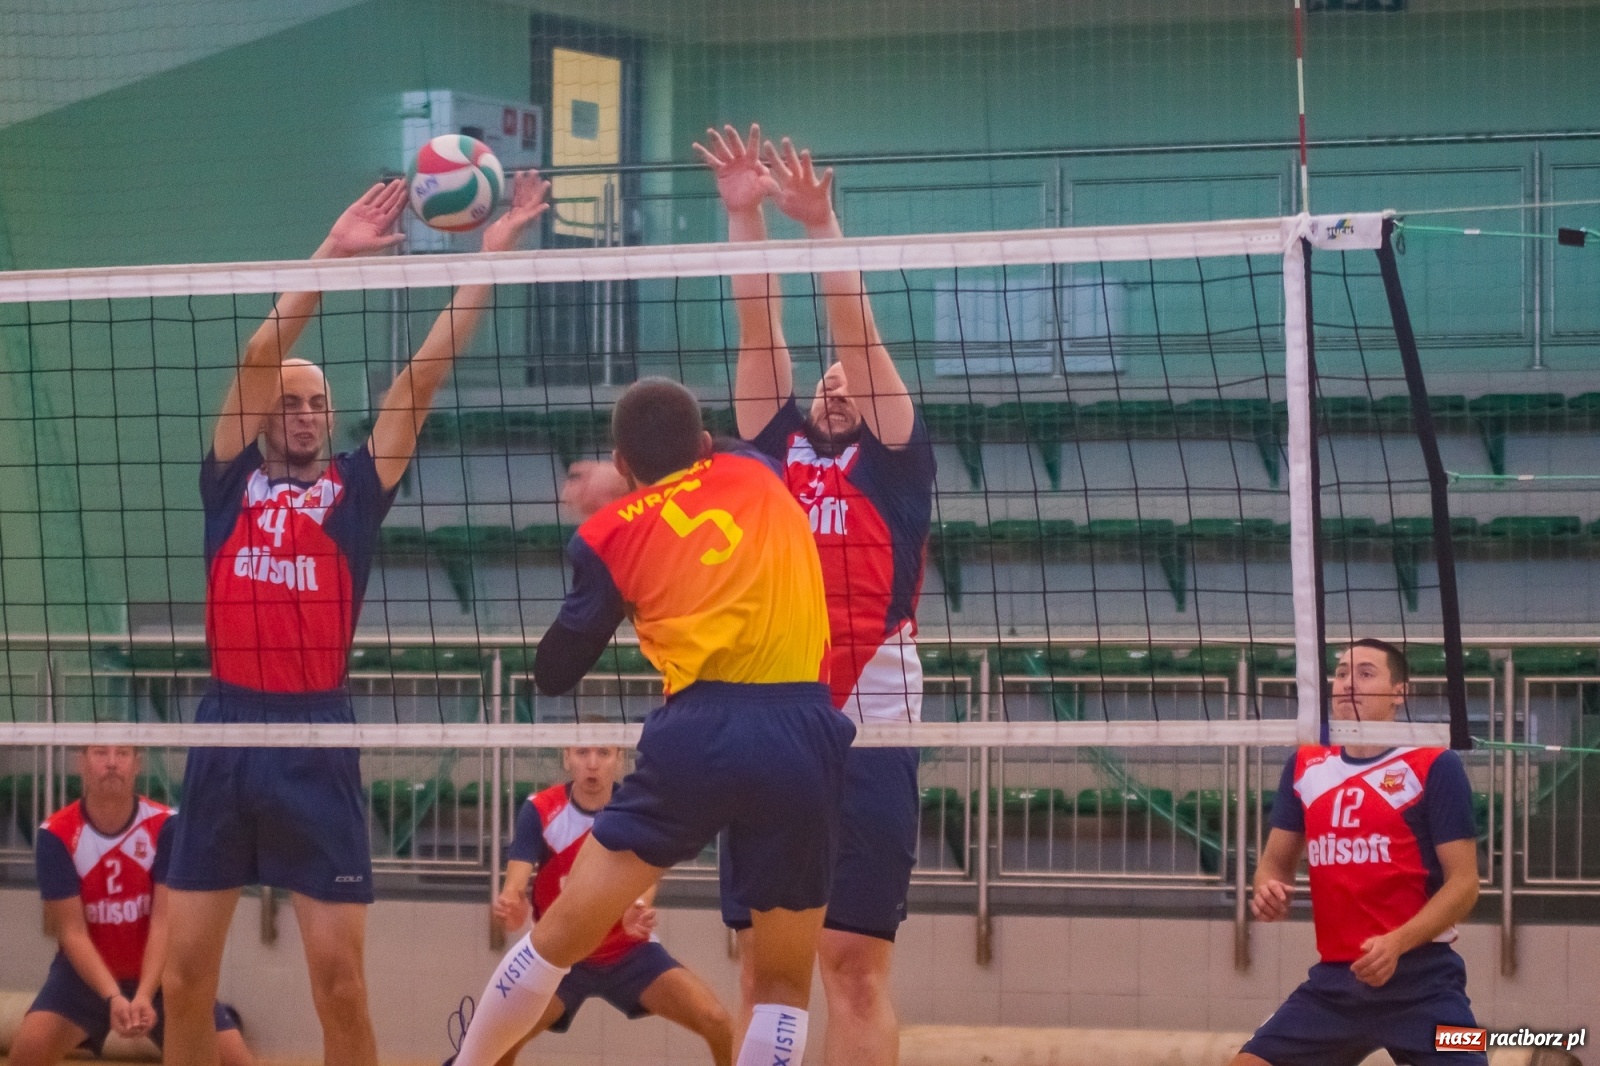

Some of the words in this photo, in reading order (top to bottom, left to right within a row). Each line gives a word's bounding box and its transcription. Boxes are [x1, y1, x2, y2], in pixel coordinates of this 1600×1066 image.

[257, 506, 286, 547] 4
[660, 479, 744, 565] 5
[234, 545, 319, 591] etisoft
[1331, 787, 1365, 828] 12
[1308, 833, 1392, 867] etisoft
[104, 859, 123, 895] 2
[495, 945, 535, 998] ALLSIX
[772, 1012, 798, 1066] ALLSIX
